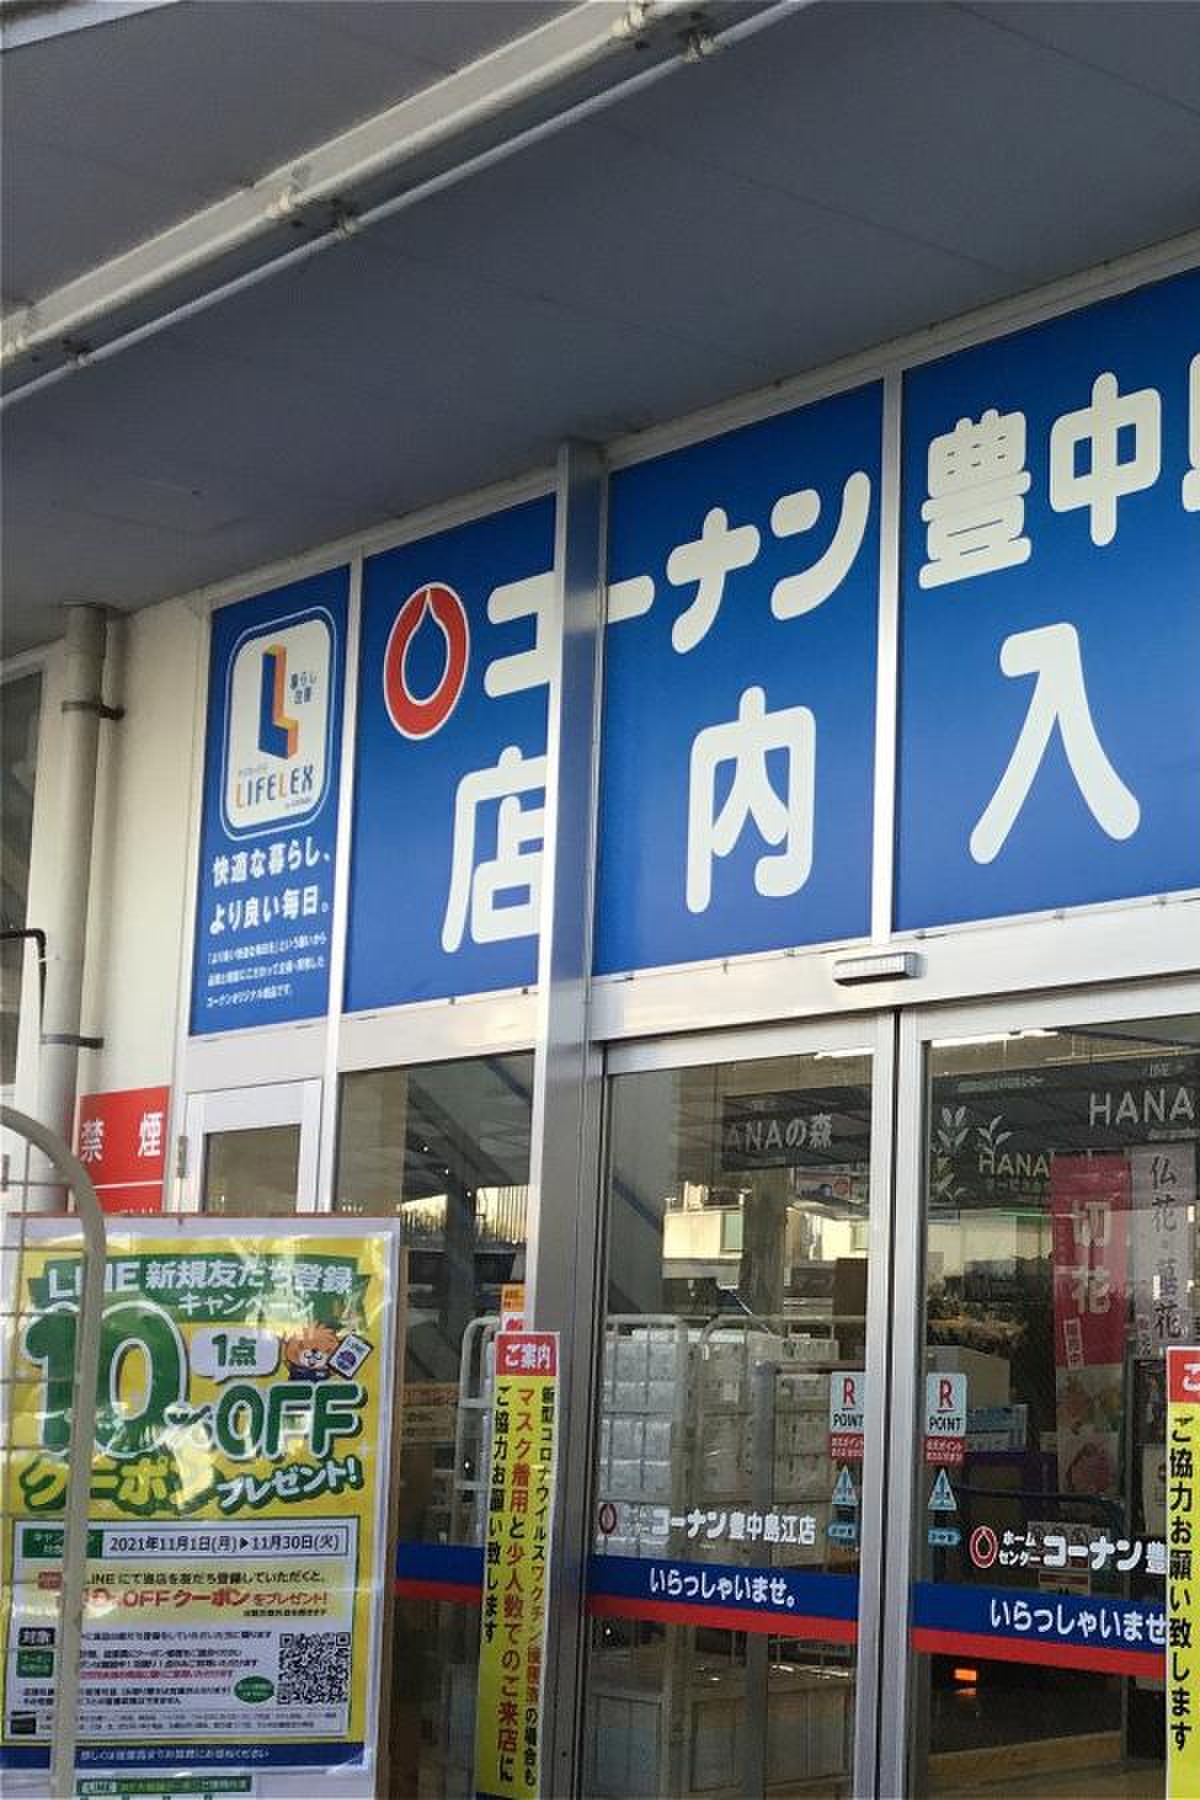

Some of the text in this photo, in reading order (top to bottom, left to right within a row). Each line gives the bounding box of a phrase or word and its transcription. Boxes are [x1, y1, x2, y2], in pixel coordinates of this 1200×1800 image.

[236, 764, 314, 809] LIFELEX
[79, 1110, 164, 1163] 禁煙
[211, 1333, 257, 1368] 1点
[504, 1343, 552, 1369] ご案内
[929, 1416, 962, 1431] POINT
[651, 1507, 817, 1546] コーナン豊中島江店
[649, 1567, 797, 1609] いらっしゃいませ。
[1168, 1415, 1194, 1752] ご協力お願い致します
